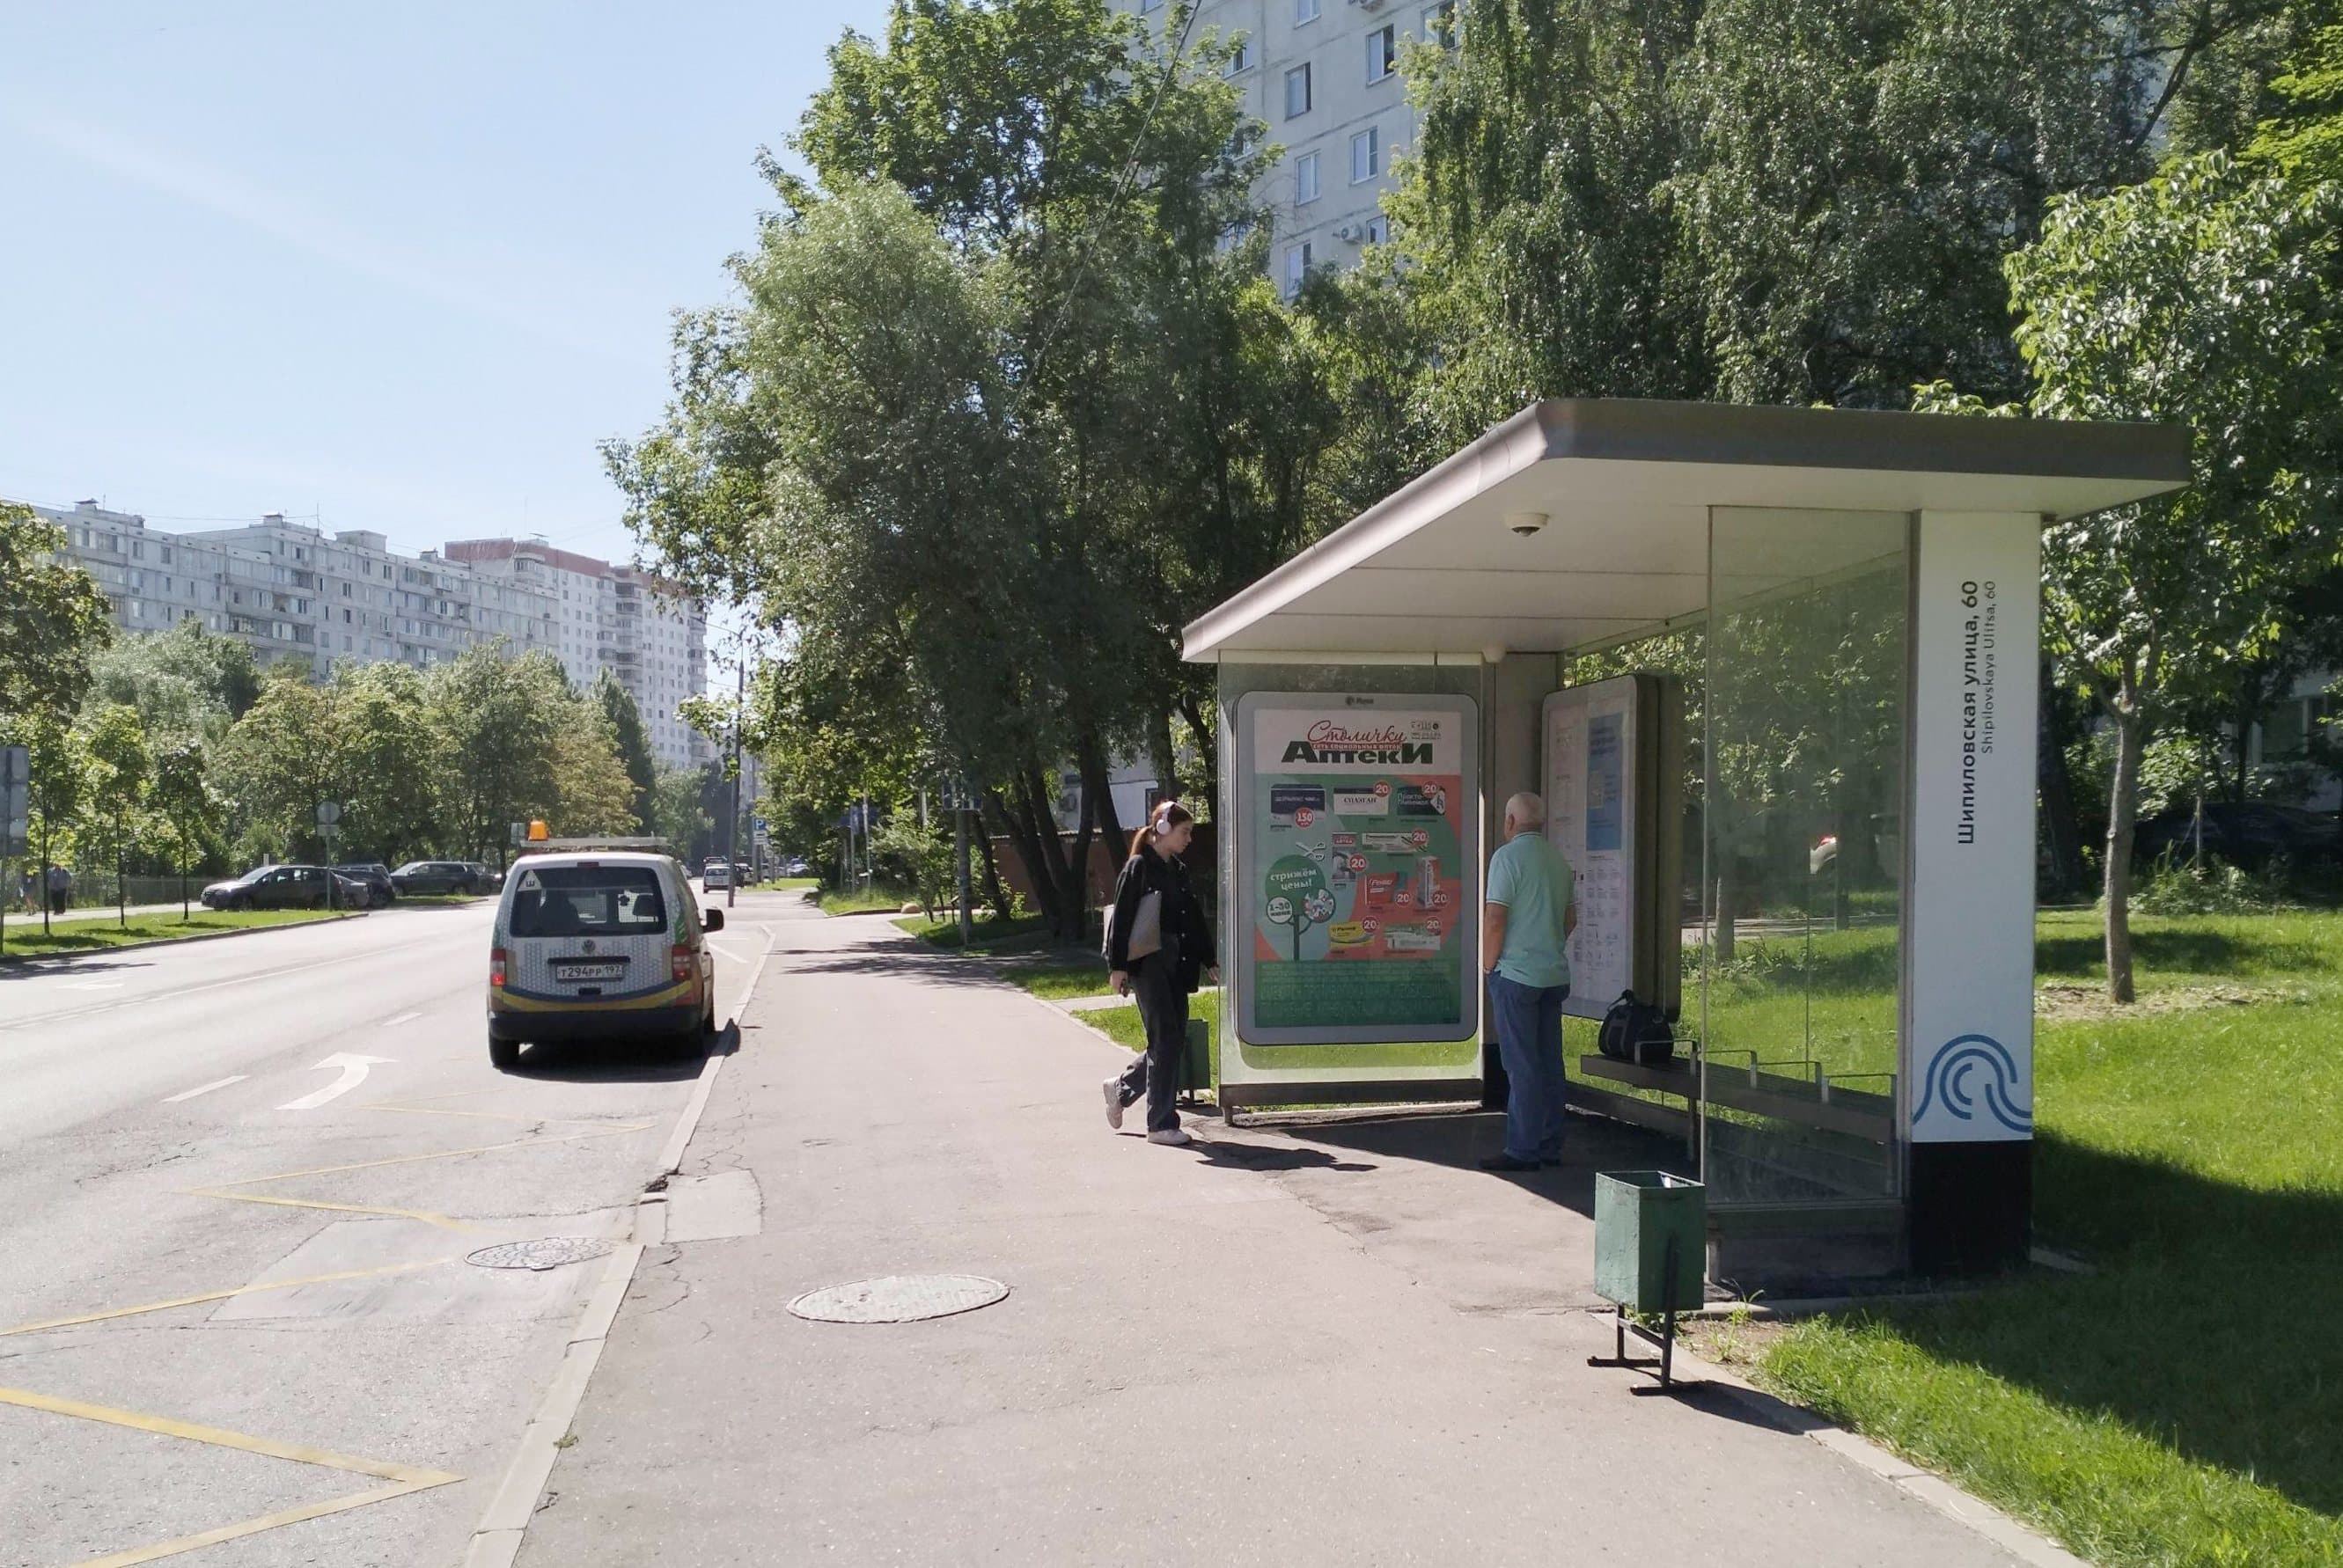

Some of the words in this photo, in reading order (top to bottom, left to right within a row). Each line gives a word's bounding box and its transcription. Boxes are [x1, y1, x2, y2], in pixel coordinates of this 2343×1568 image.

[1961, 580, 1979, 609] 60
[1983, 580, 1996, 599] 60
[1983, 603, 1996, 648] Ulitsa,
[1962, 614, 1980, 686] улица,
[1981, 653, 1995, 754] Shipilovskaya
[1307, 720, 1407, 743] Столички
[1957, 692, 1977, 845] Шипиловская
[1375, 783, 1389, 794] 20
[1424, 783, 1437, 794] 20
[1296, 811, 1313, 823] 150
[1413, 832, 1426, 842] 20
[1350, 858, 1365, 868] 20
[1270, 867, 1318, 883] стрижём
[1281, 878, 1313, 891] цены!
[1396, 893, 1410, 903] 20
[1434, 893, 1447, 904] 20
[1363, 920, 1377, 929] 20
[1426, 920, 1439, 929] 20
